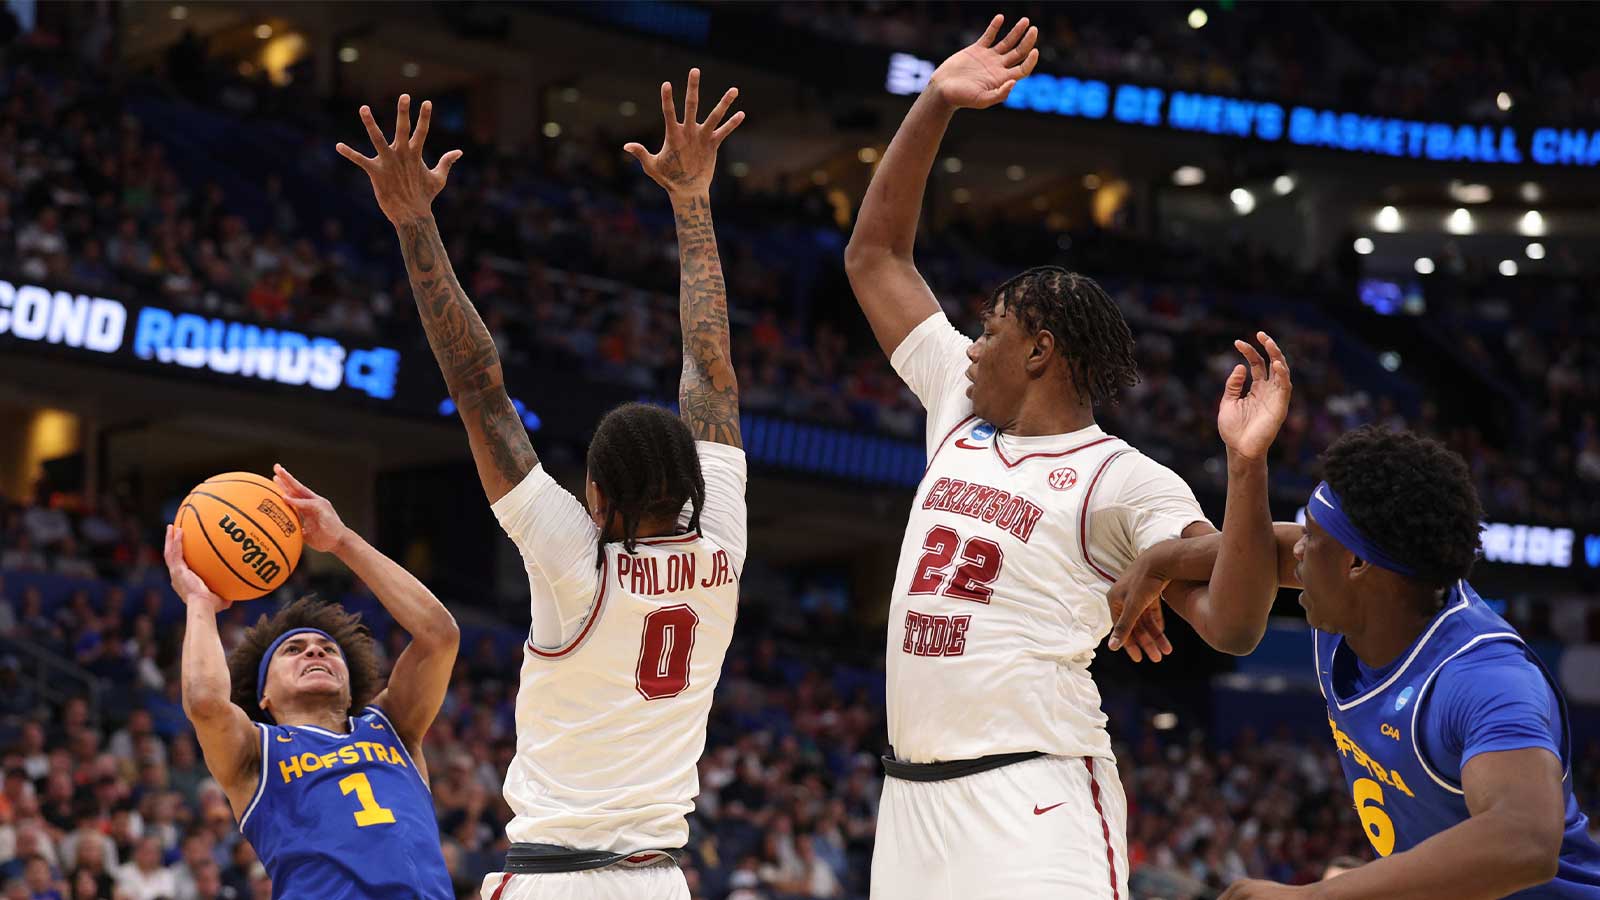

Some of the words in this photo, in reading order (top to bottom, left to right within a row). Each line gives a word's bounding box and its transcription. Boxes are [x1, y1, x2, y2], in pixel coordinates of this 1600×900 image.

[1168, 91, 1285, 141] MEN'S
[1288, 105, 1523, 165] BASKETBALL
[134, 306, 346, 391] ROUNDS
[922, 477, 1044, 544] CRIMSON
[1050, 468, 1076, 489] SEC
[218, 514, 281, 584] Wilson
[617, 552, 695, 595] PHILON
[701, 549, 733, 588] JR.
[908, 524, 1004, 605] 22
[635, 603, 699, 700] 0
[903, 610, 972, 657] TIDE
[278, 741, 408, 784] HOFSTRA
[1380, 723, 1400, 741] CAA
[338, 772, 396, 827] 1
[1353, 777, 1395, 857] 6
